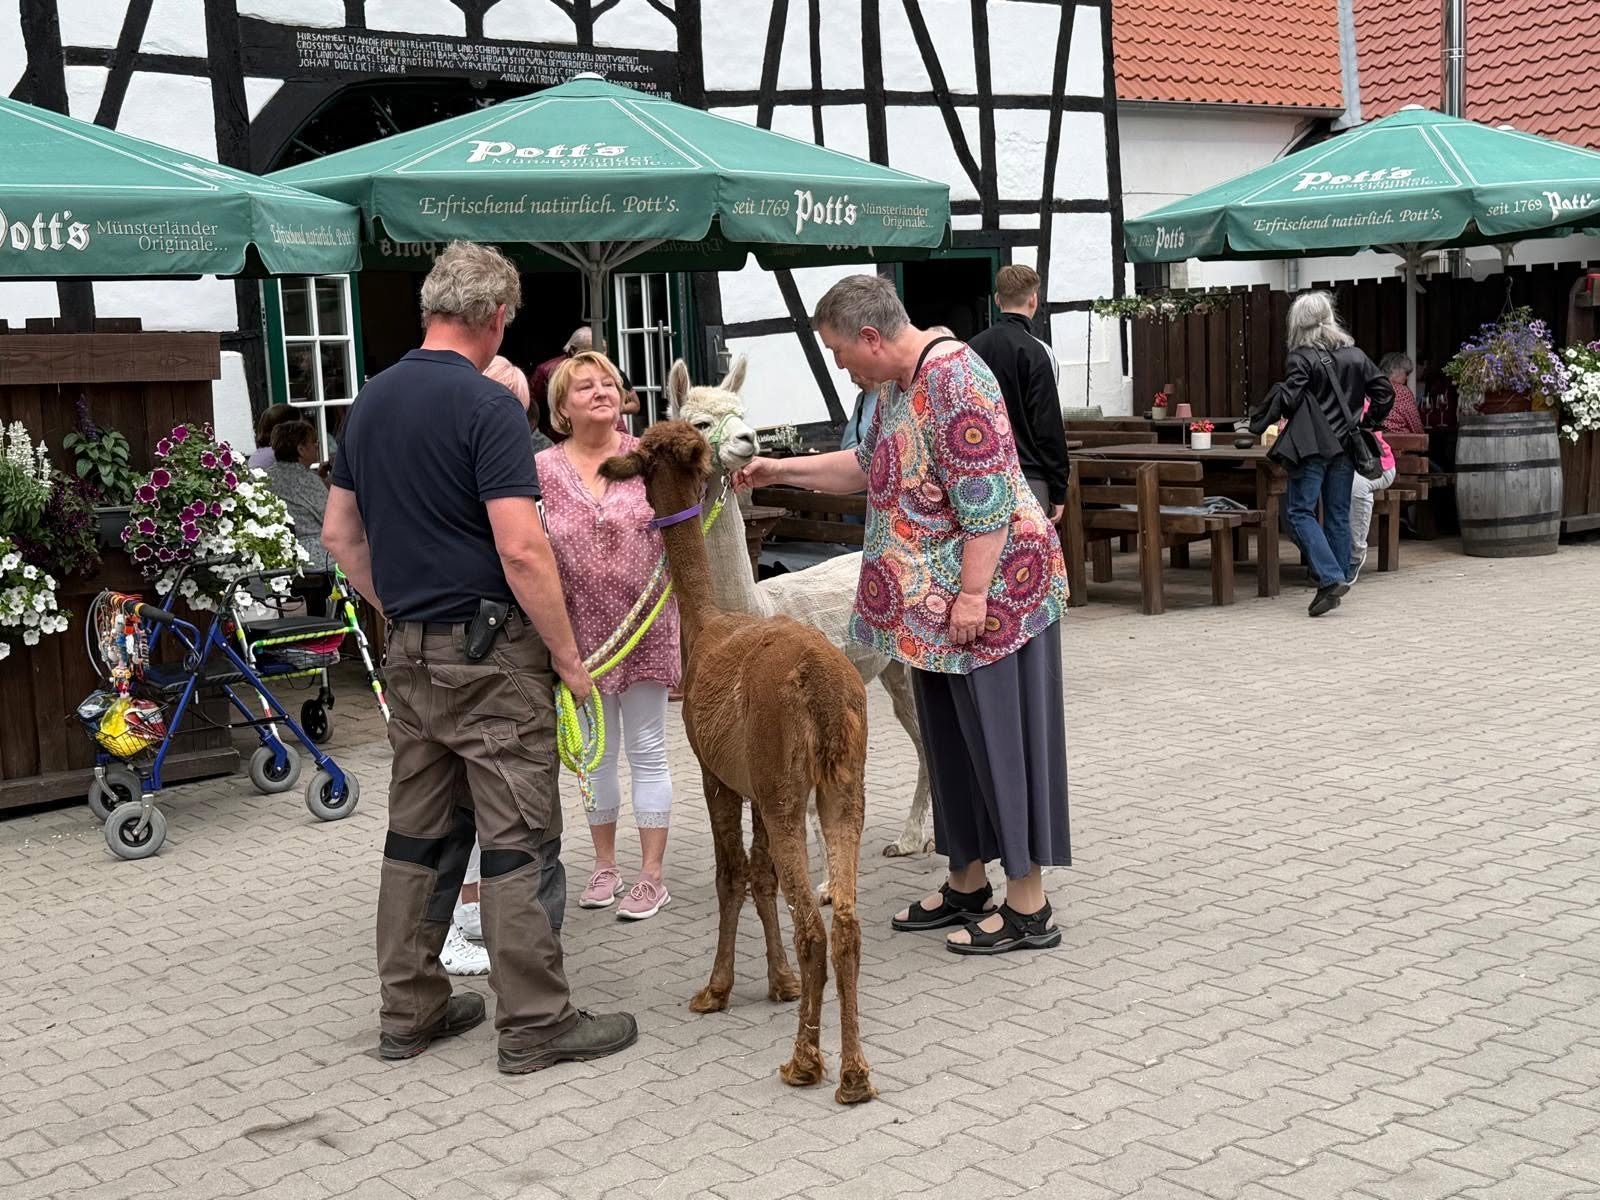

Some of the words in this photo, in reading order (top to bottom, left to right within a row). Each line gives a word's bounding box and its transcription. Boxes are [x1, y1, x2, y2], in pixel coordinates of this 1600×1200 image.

[298, 58, 330, 68] JOHAN
[466, 140, 629, 163] Pott's
[1292, 166, 1416, 192] Pott's
[419, 194, 528, 222] Erfrischend
[530, 193, 616, 215] natürlich.
[622, 195, 680, 214] Pott's.
[732, 198, 756, 215] seit
[758, 199, 790, 217] 1769
[793, 189, 857, 236] Pott's
[862, 202, 929, 217] Münsterländer
[1486, 201, 1511, 217] seit
[1513, 199, 1543, 214] 1769
[96, 220, 219, 236] Münsterländer
[1253, 213, 1332, 236] Erfrischend
[1332, 209, 1395, 228] natürlich.
[1400, 207, 1442, 223] Pott's.
[138, 233, 229, 254] Originale...
[1154, 225, 1185, 257] Pott's
